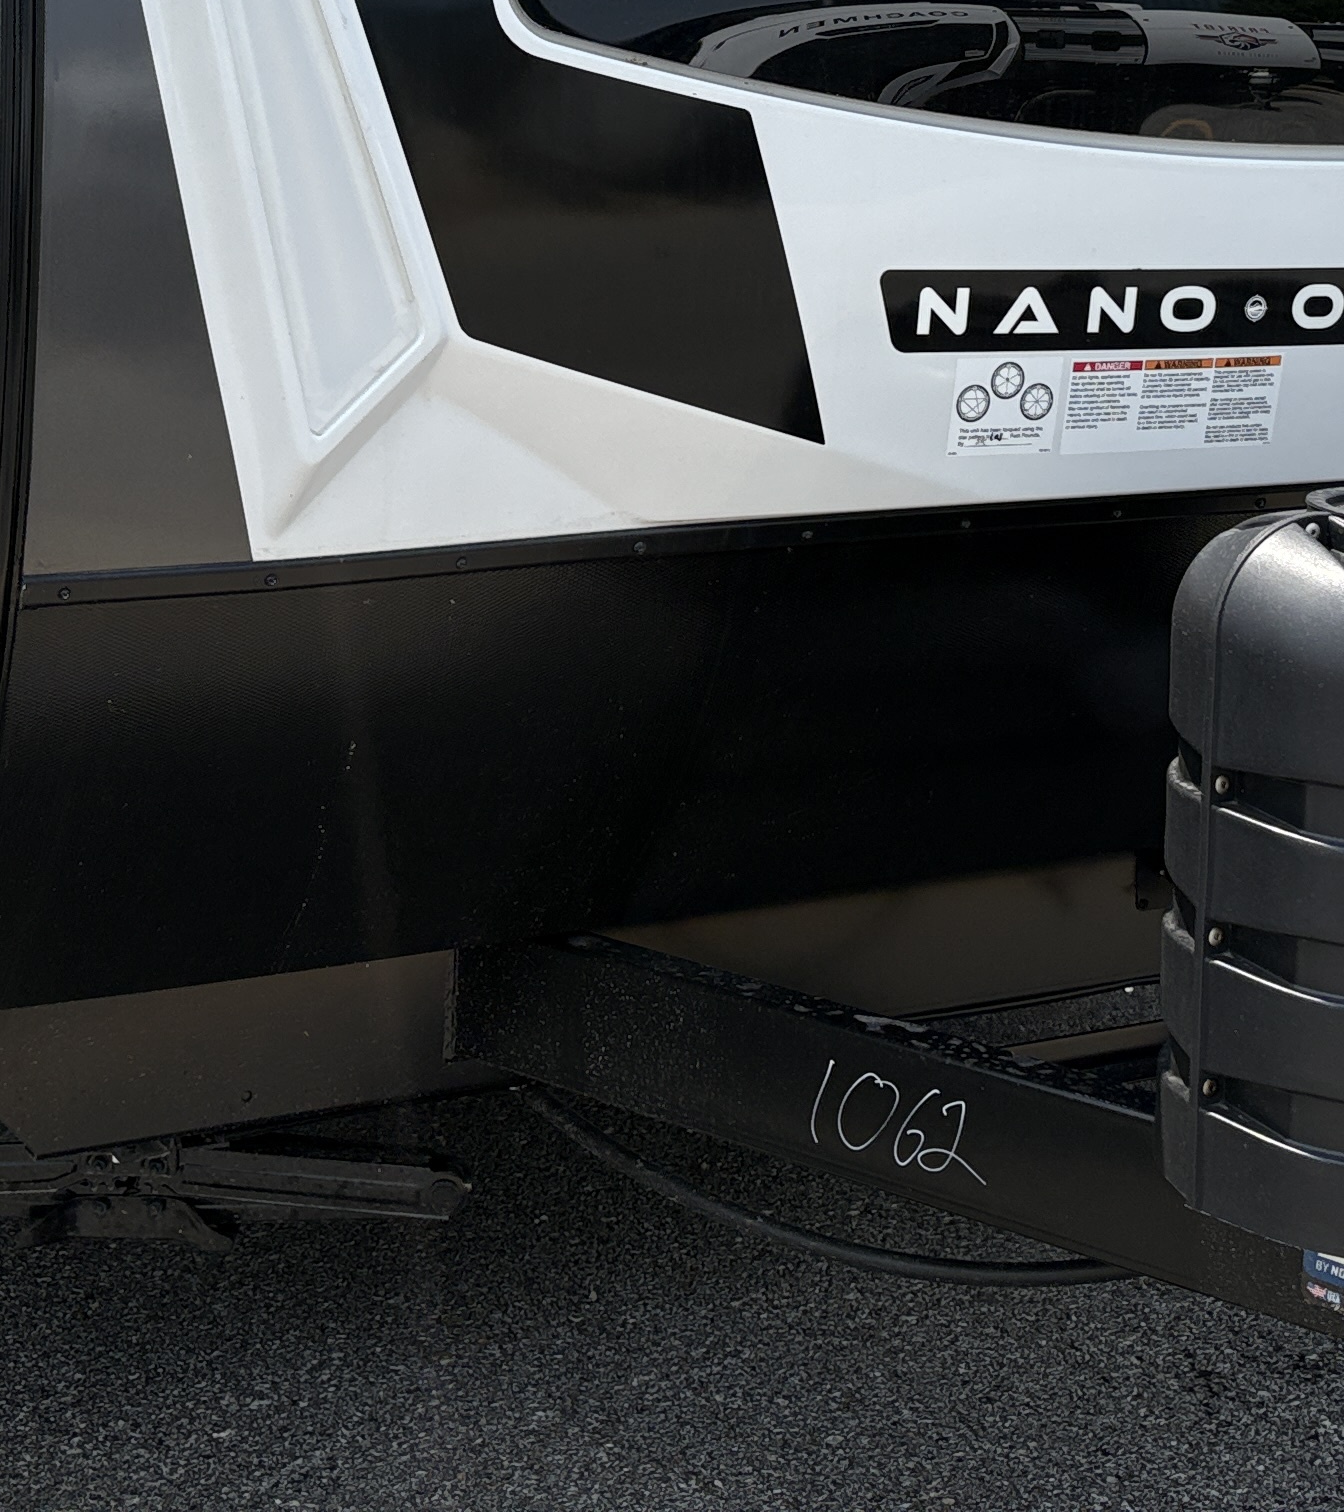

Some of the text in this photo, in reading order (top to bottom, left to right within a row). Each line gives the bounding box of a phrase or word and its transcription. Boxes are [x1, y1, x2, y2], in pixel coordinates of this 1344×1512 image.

[916, 286, 1216, 335] NANO
[1095, 362, 1131, 370] DANGER
[811, 1060, 987, 1185] 1062
[1316, 1260, 1330, 1272] BY
